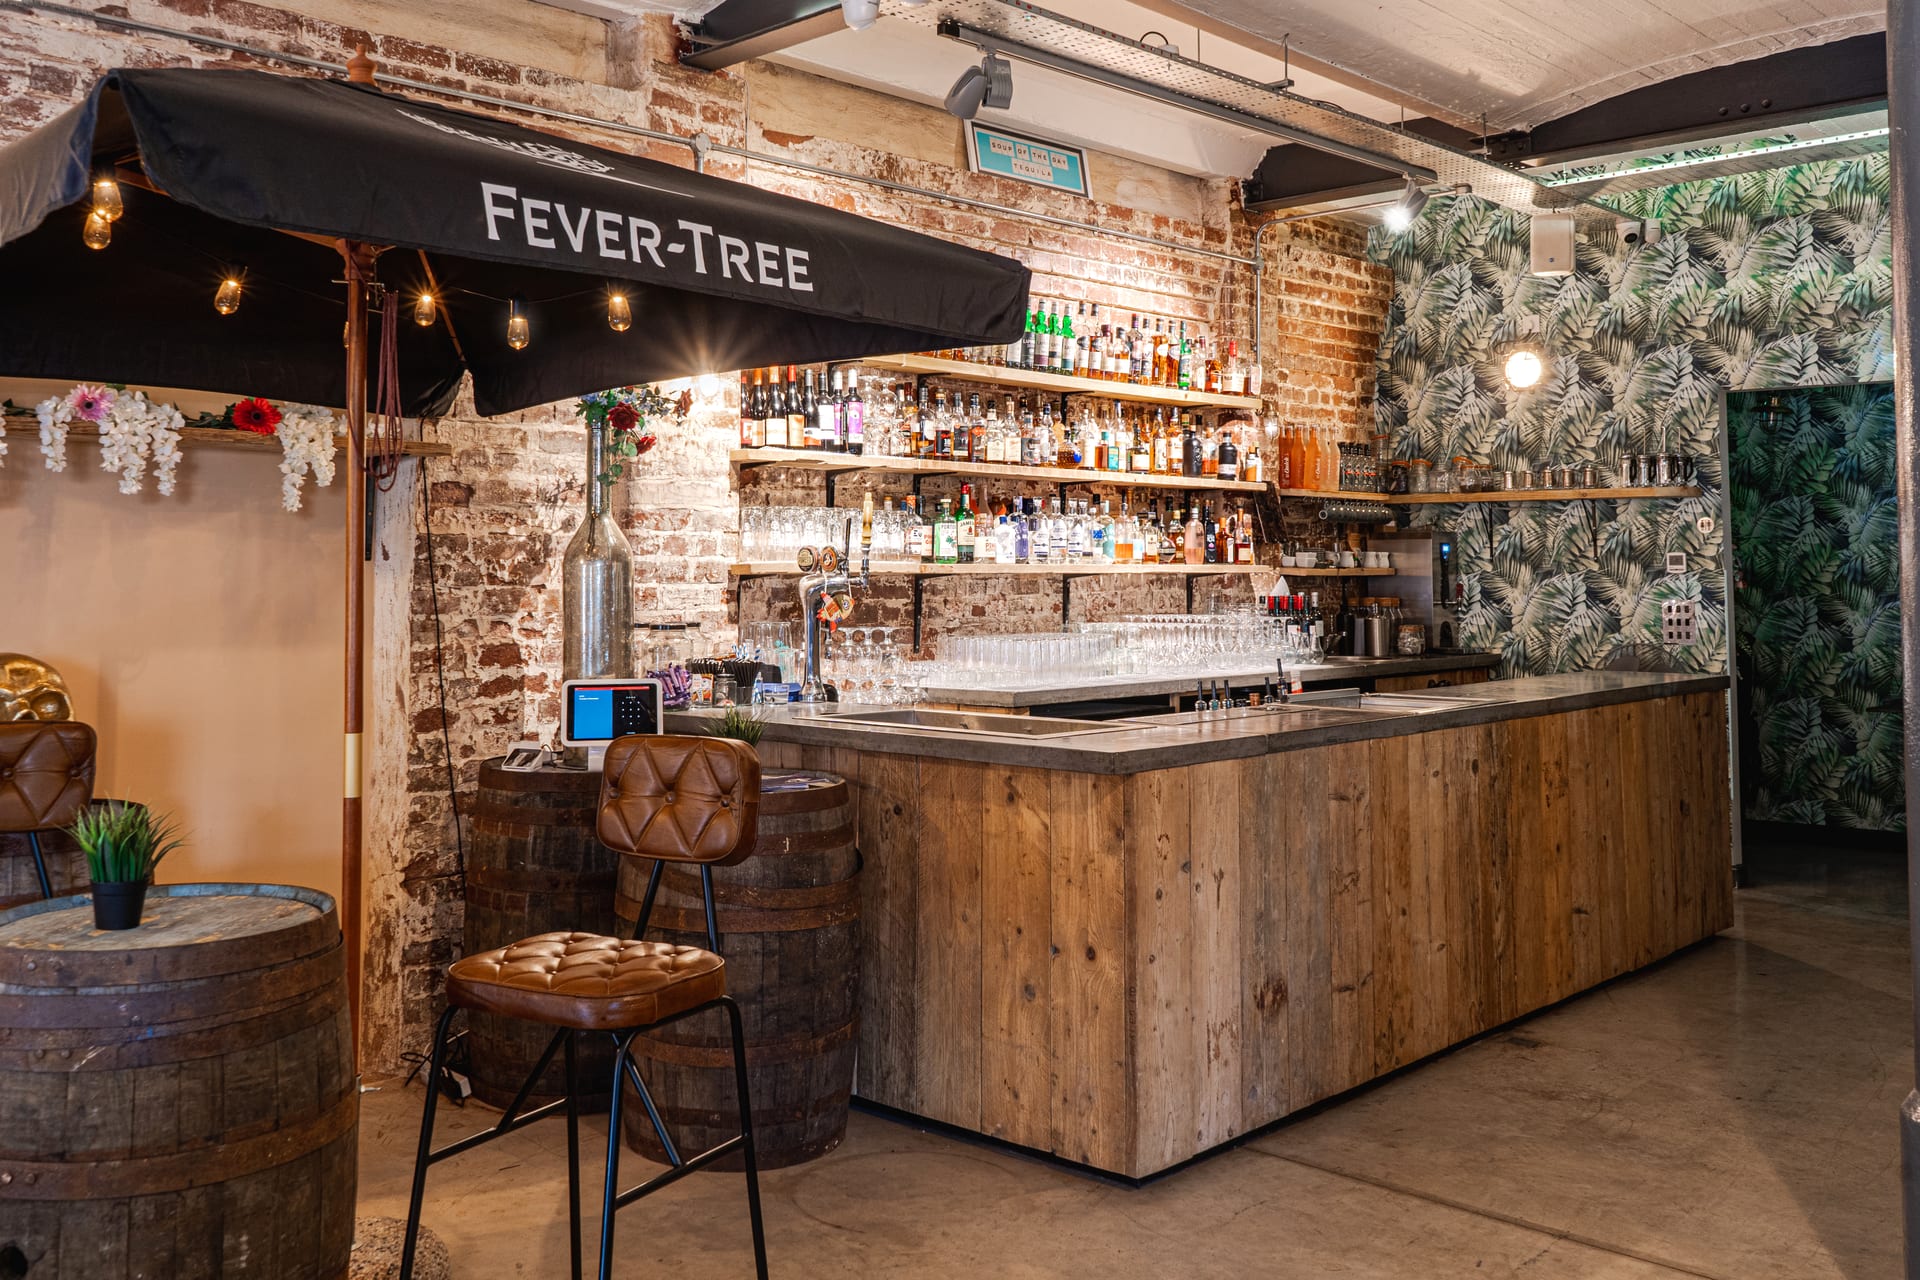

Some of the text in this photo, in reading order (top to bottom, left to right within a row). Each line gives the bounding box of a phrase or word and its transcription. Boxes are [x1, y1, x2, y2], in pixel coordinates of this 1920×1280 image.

[991, 142, 1013, 152] SOUP
[1032, 152, 1047, 161] THE
[1052, 157, 1067, 166] DAY
[1013, 162, 1052, 177] TEQUILA
[480, 181, 814, 292] FEVER-TREE
